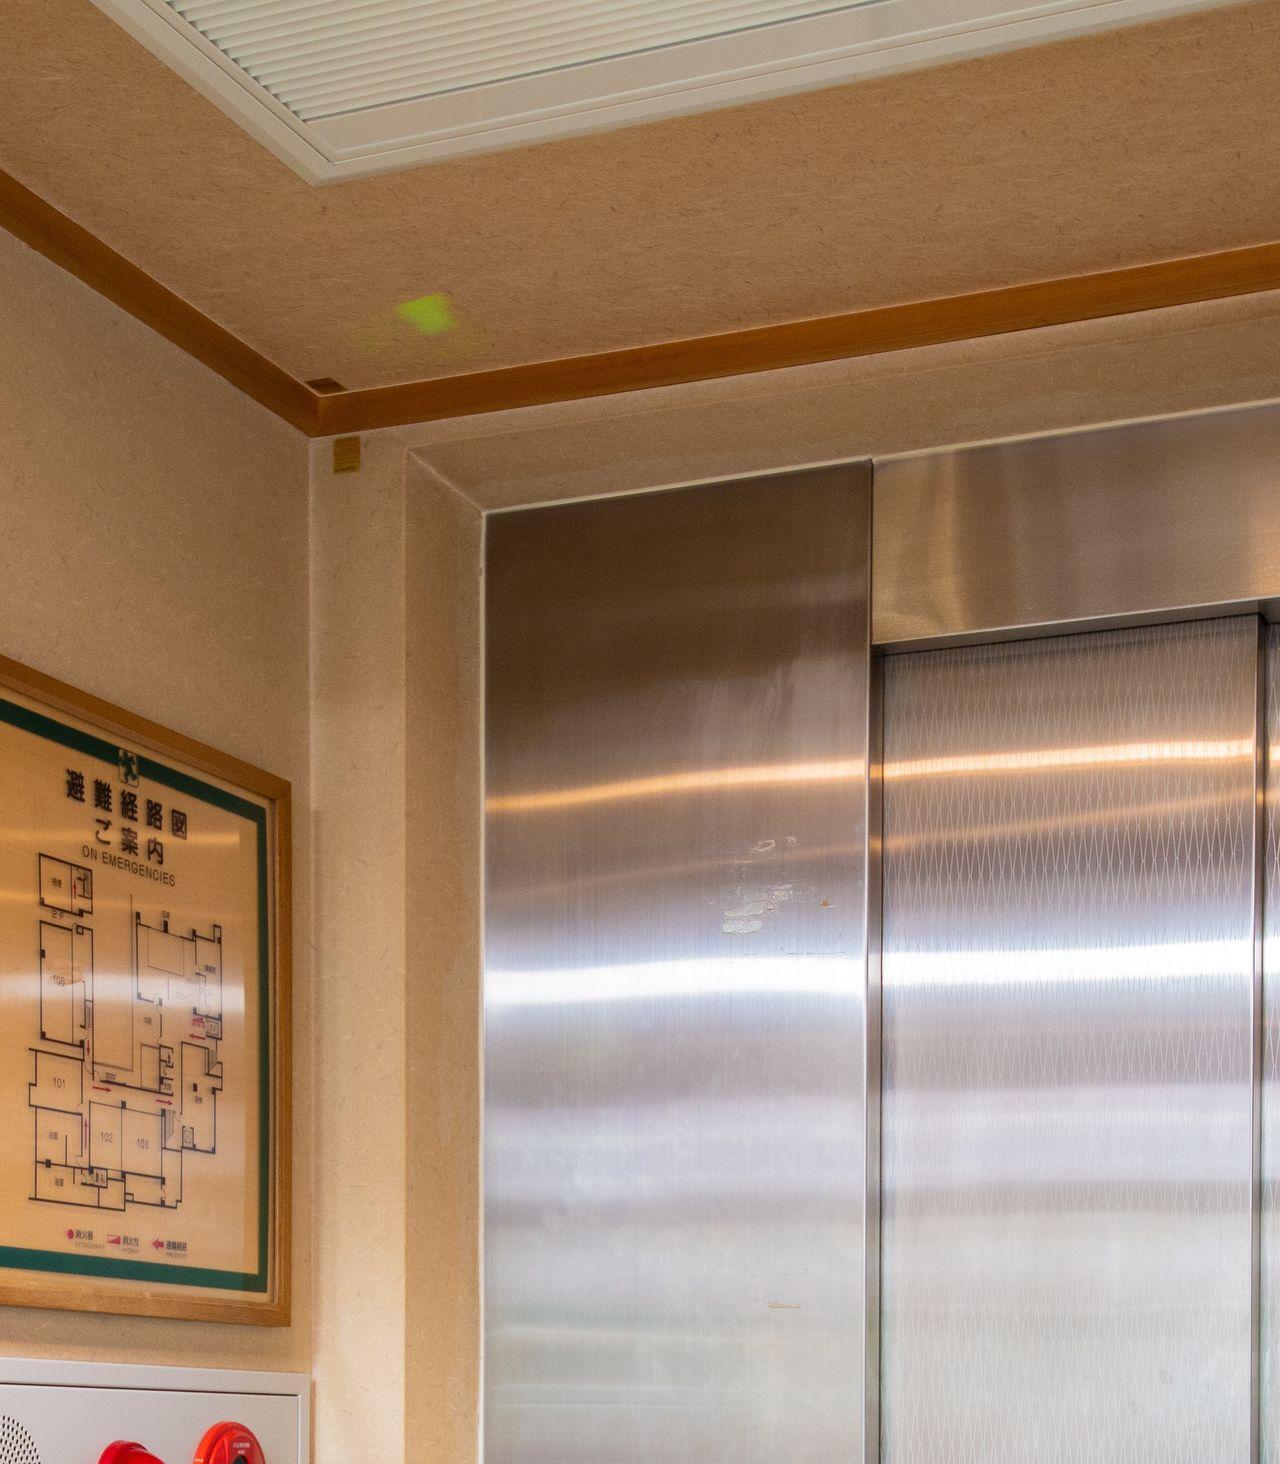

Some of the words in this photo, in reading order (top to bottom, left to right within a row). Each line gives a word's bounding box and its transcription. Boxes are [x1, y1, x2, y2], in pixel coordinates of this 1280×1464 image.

[67, 769, 187, 840] 避難経路図
[96, 818, 164, 865] ご案内
[82, 845, 98, 861] ON
[102, 853, 175, 887] EMERGENCIES
[53, 1077, 66, 1089] 101
[100, 1131, 113, 1144] 102
[136, 1138, 150, 1150] 103
